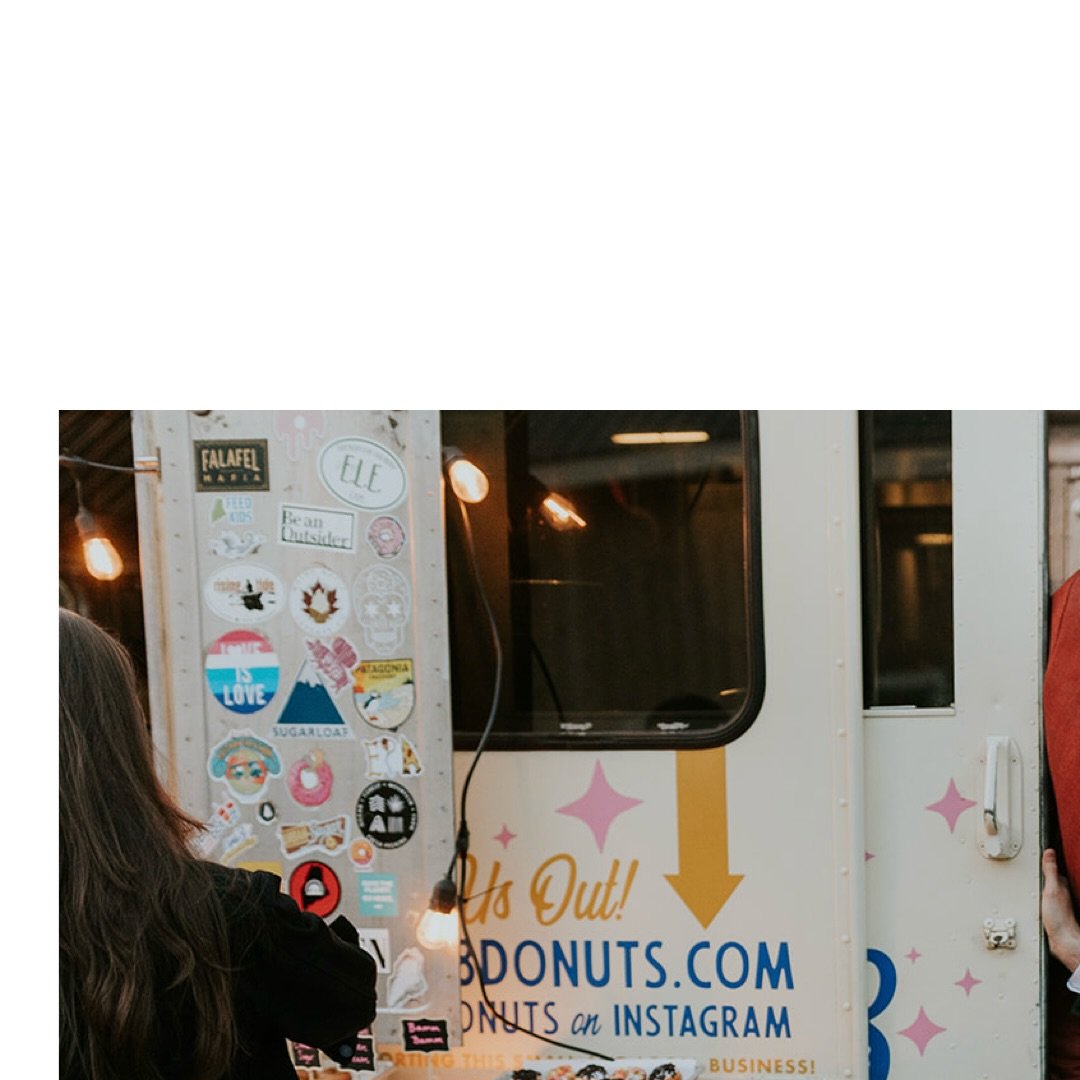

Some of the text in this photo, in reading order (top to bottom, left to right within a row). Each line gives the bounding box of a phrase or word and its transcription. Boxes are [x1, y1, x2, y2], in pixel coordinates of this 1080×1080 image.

[202, 447, 261, 472] FALAFEL
[203, 473, 261, 482] MAFIA
[340, 454, 384, 493] ELE
[282, 509, 323, 529] Be an
[281, 526, 349, 547] Outsider
[235, 667, 253, 683] IS
[222, 684, 267, 706] LOVE
[272, 726, 349, 737] SUGARLOAF
[464, 853, 640, 926] Us Out!
[571, 1010, 602, 1036] on
[613, 1004, 792, 1038] INSTAGRAM
[463, 1053, 504, 1068] THIS
[709, 1058, 816, 1074] BUSINESS!
